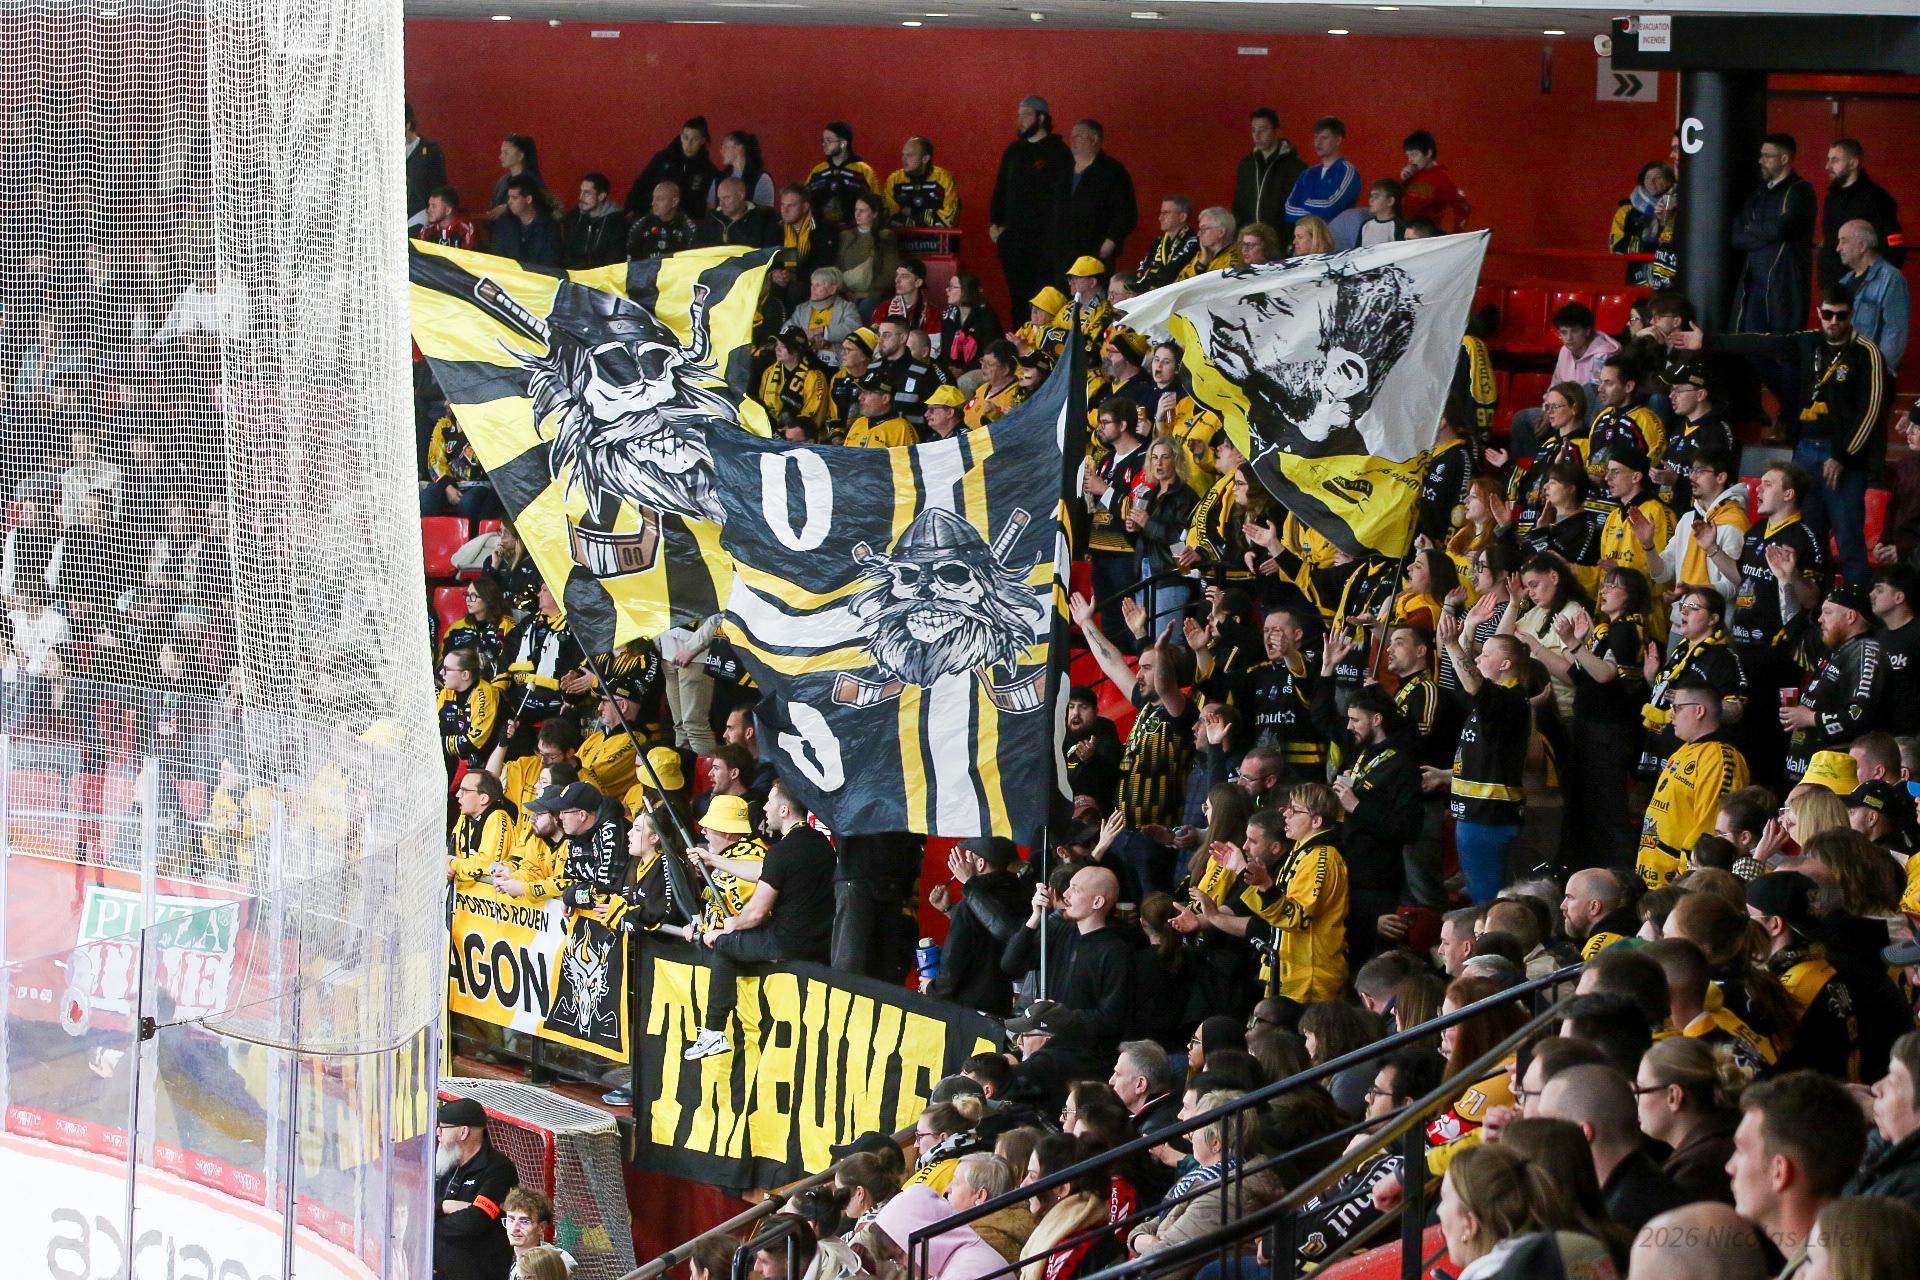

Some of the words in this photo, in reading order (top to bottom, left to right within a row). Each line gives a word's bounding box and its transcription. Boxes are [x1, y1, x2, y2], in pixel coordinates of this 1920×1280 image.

[1680, 117, 1704, 155] C
[601, 820, 617, 885] Matmut
[510, 905, 549, 933] ROUEN
